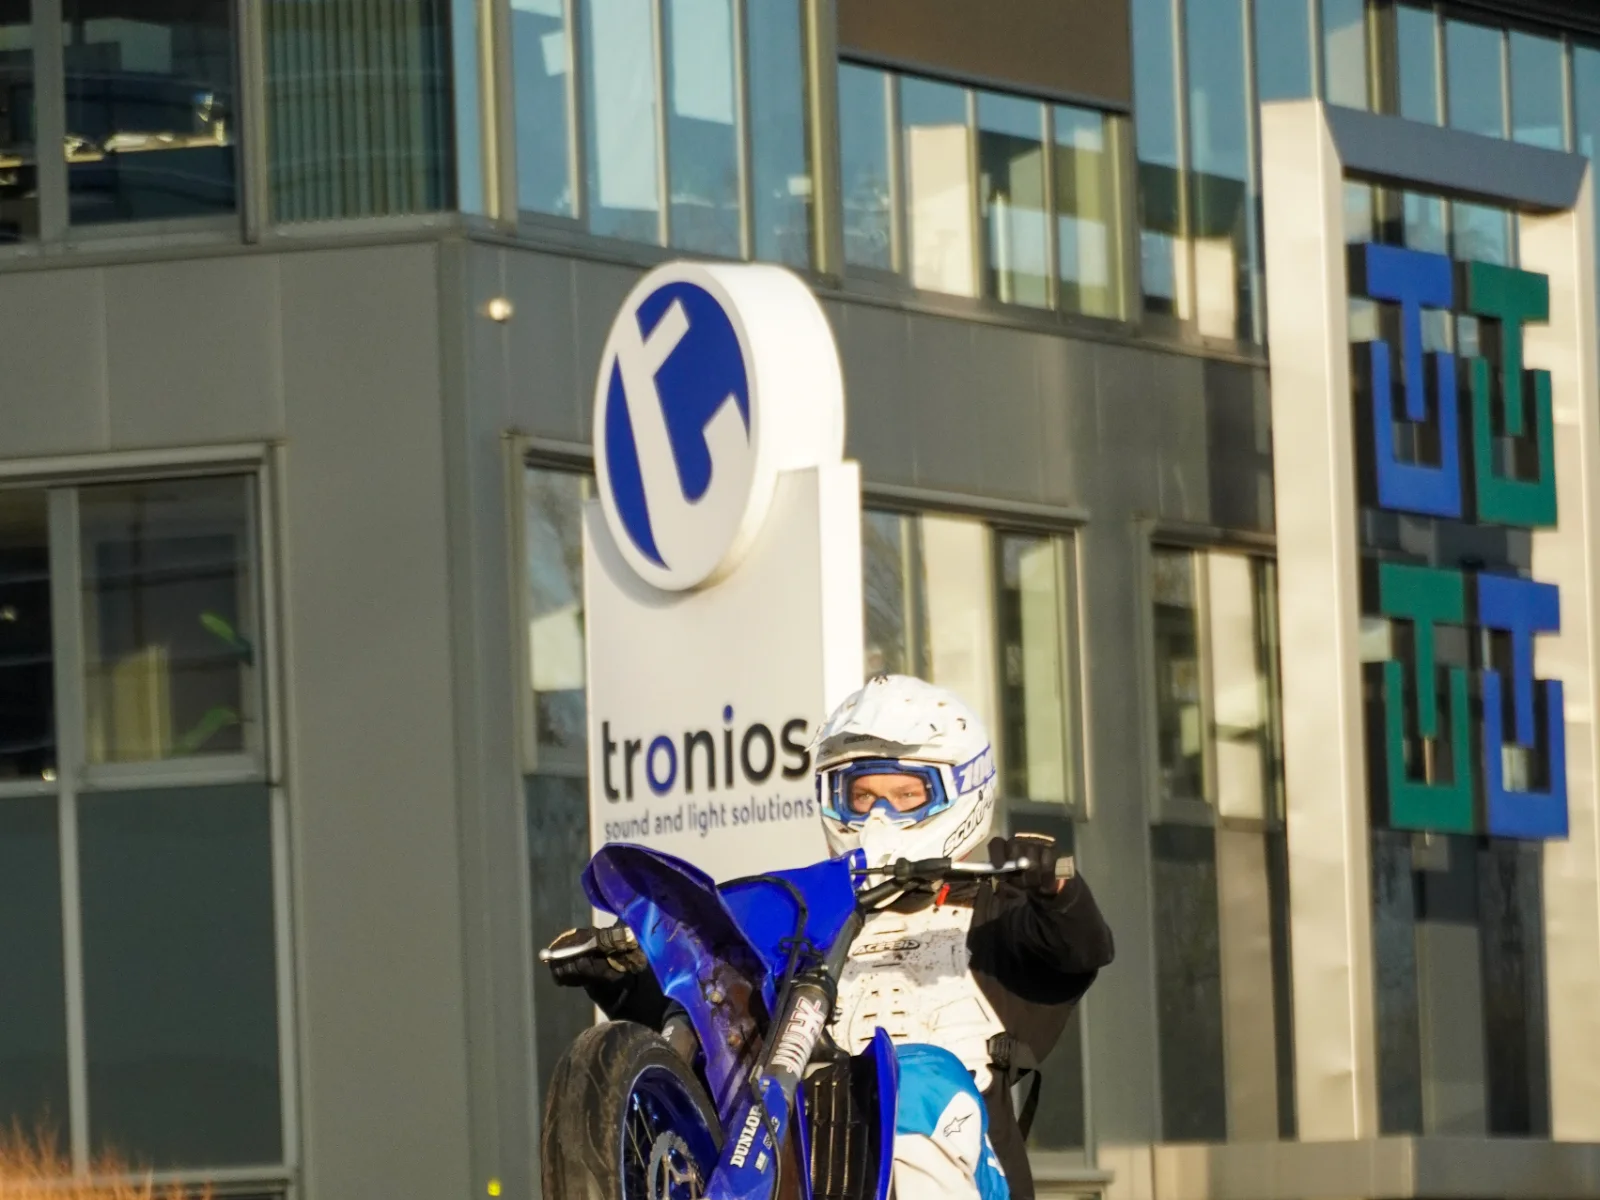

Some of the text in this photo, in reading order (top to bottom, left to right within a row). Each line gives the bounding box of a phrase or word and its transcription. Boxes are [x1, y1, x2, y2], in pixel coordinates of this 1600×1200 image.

[601, 704, 811, 804] tronios
[604, 795, 815, 841] sound and light solutions
